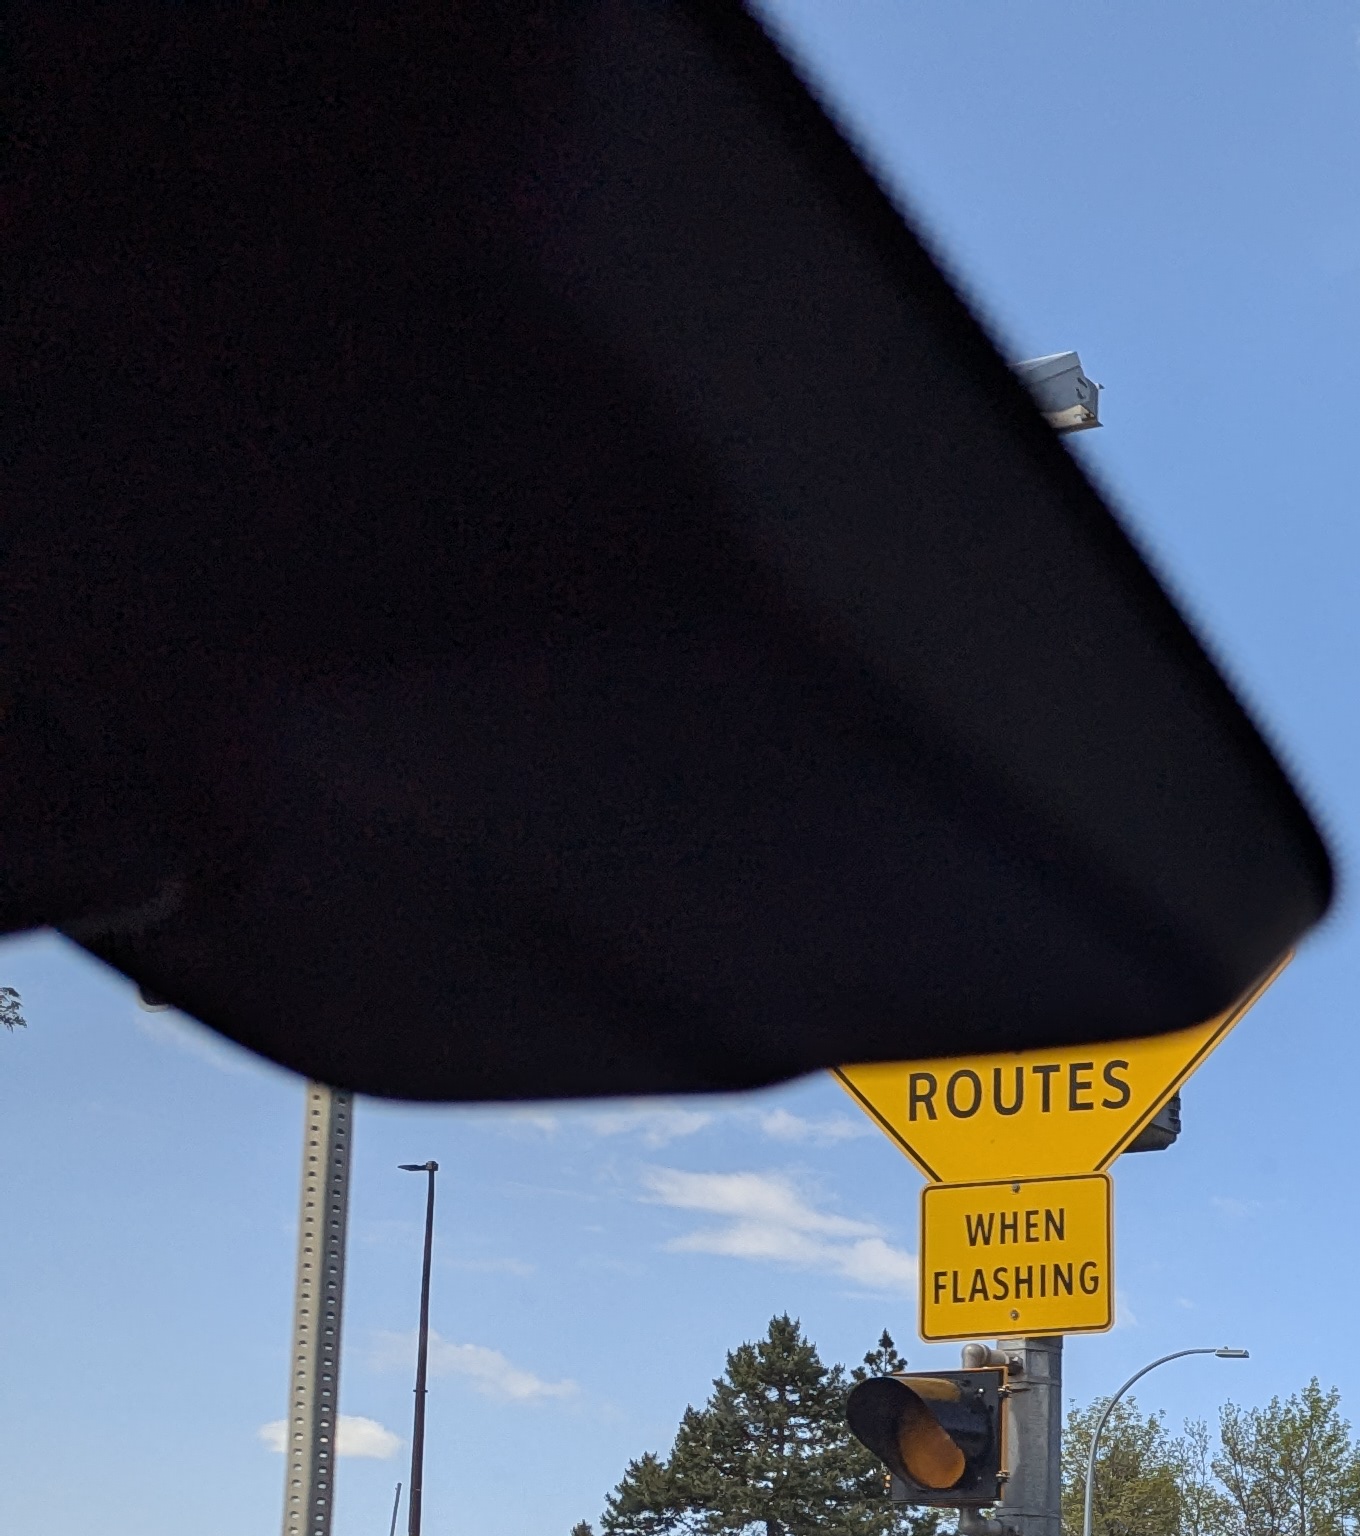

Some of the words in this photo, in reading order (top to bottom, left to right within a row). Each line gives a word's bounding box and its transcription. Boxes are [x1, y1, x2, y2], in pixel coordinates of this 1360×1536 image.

[908, 1058, 1132, 1122] ROUTES
[964, 1207, 1066, 1247] WHEN
[932, 1260, 1101, 1305] FLASHING
